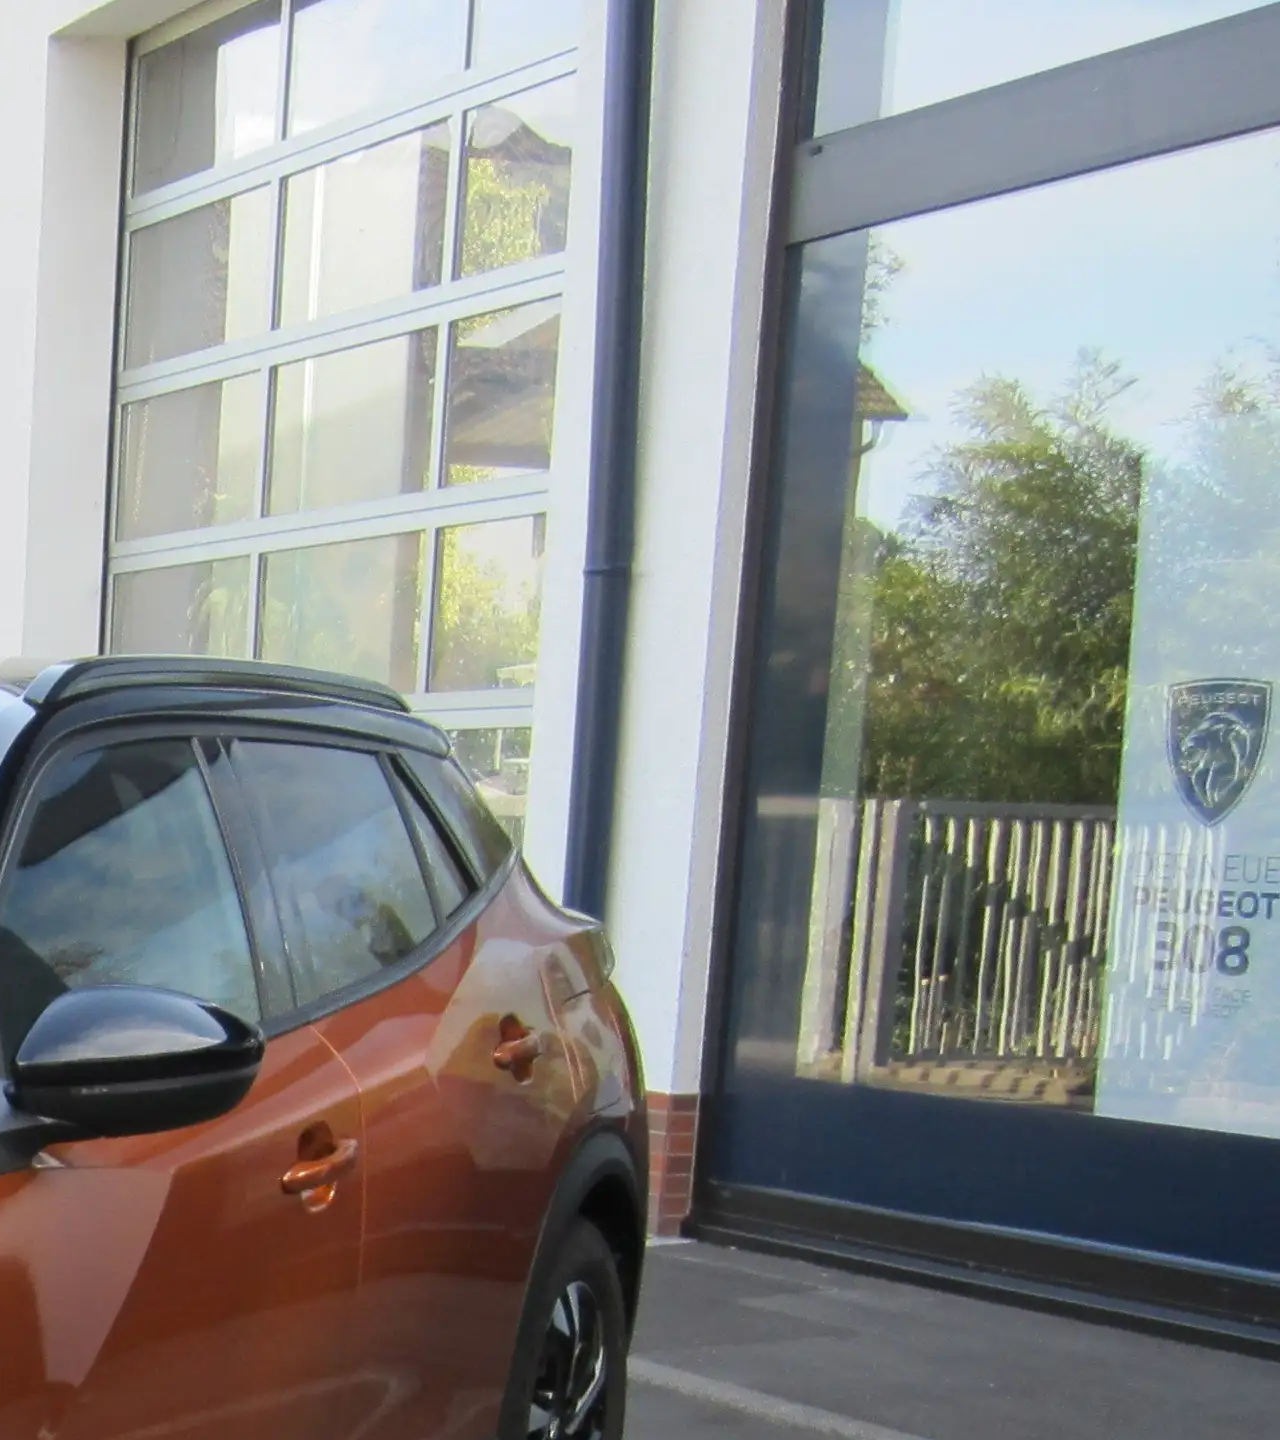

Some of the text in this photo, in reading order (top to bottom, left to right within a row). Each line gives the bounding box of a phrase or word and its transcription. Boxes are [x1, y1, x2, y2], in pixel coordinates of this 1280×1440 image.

[1176, 690, 1260, 706] PEUGEOT
[1134, 886, 1280, 920] PEUGEOT
[1153, 921, 1251, 976] 308
